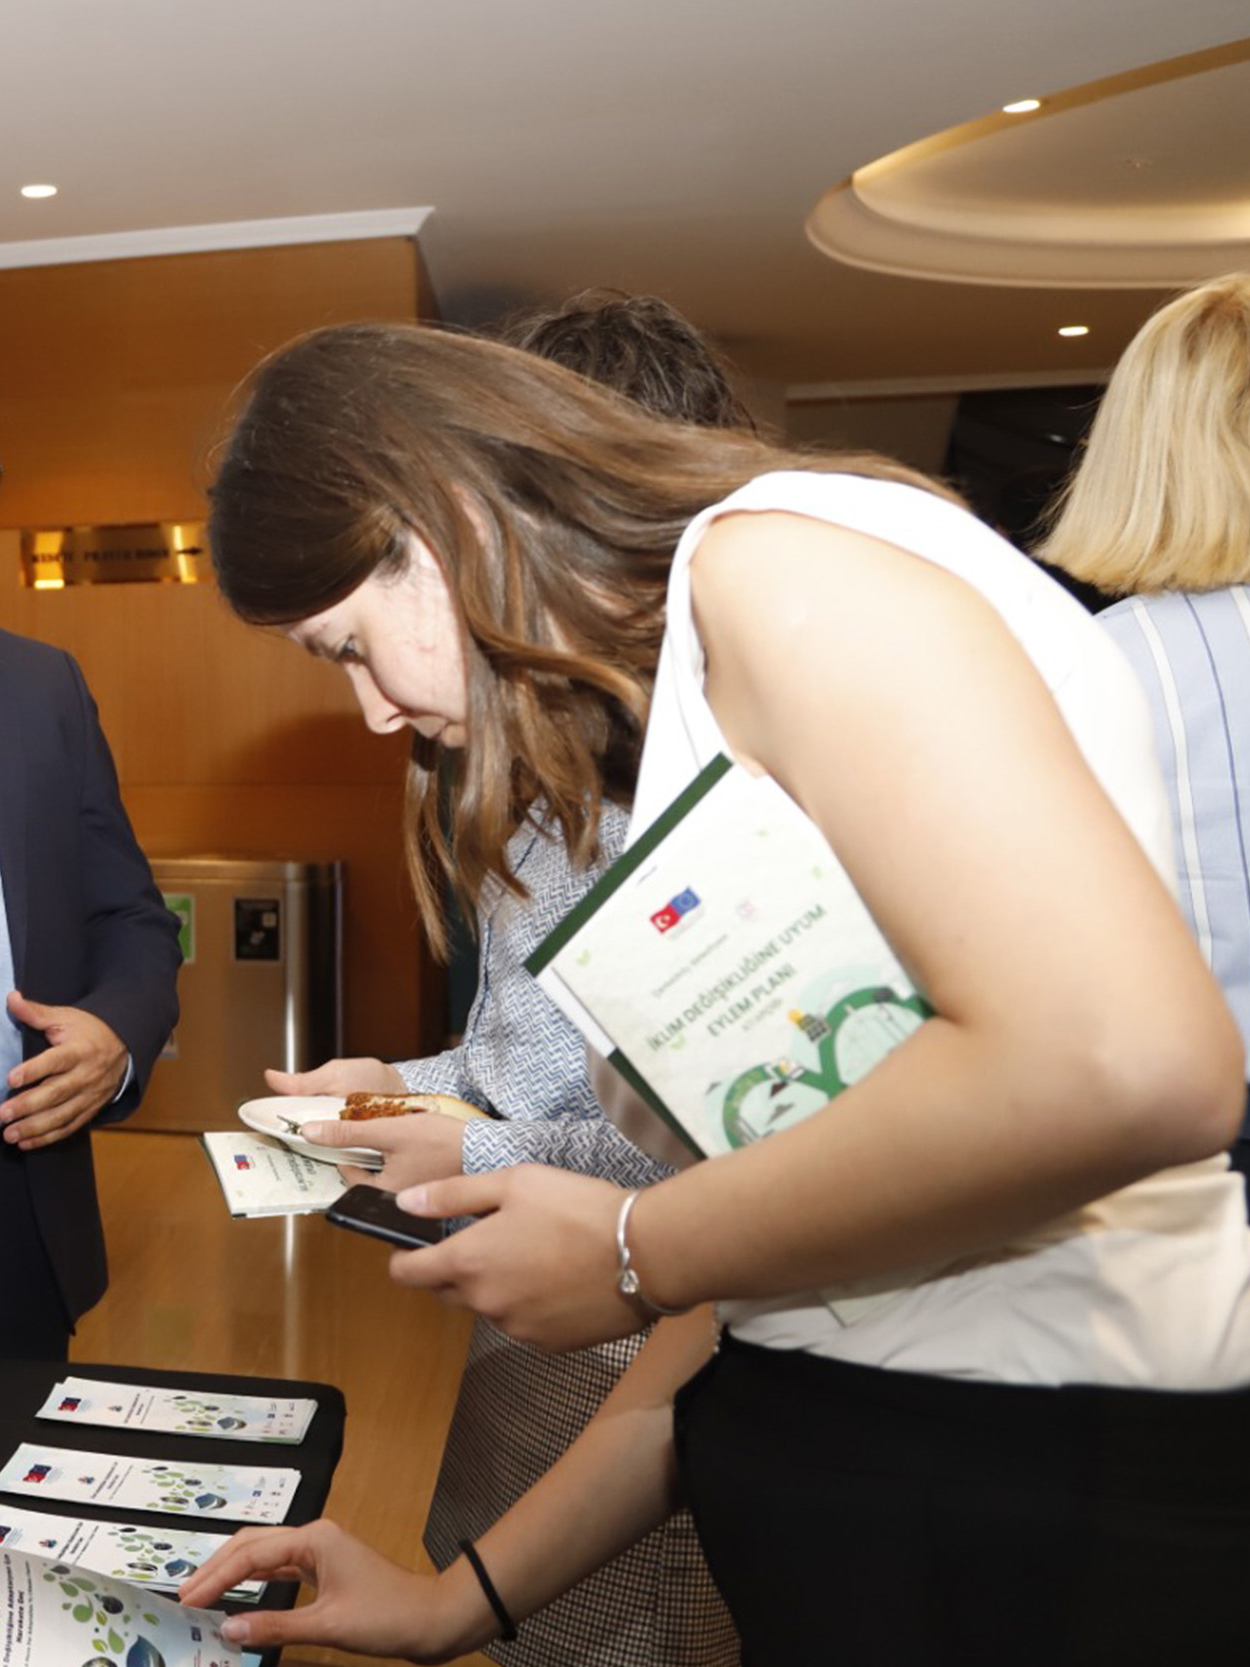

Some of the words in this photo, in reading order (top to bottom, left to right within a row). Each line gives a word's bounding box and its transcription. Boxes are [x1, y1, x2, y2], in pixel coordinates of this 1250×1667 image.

[778, 903, 826, 945] UYUM
[707, 997, 753, 1036] EYLEM
[750, 964, 797, 1002] PLANI
